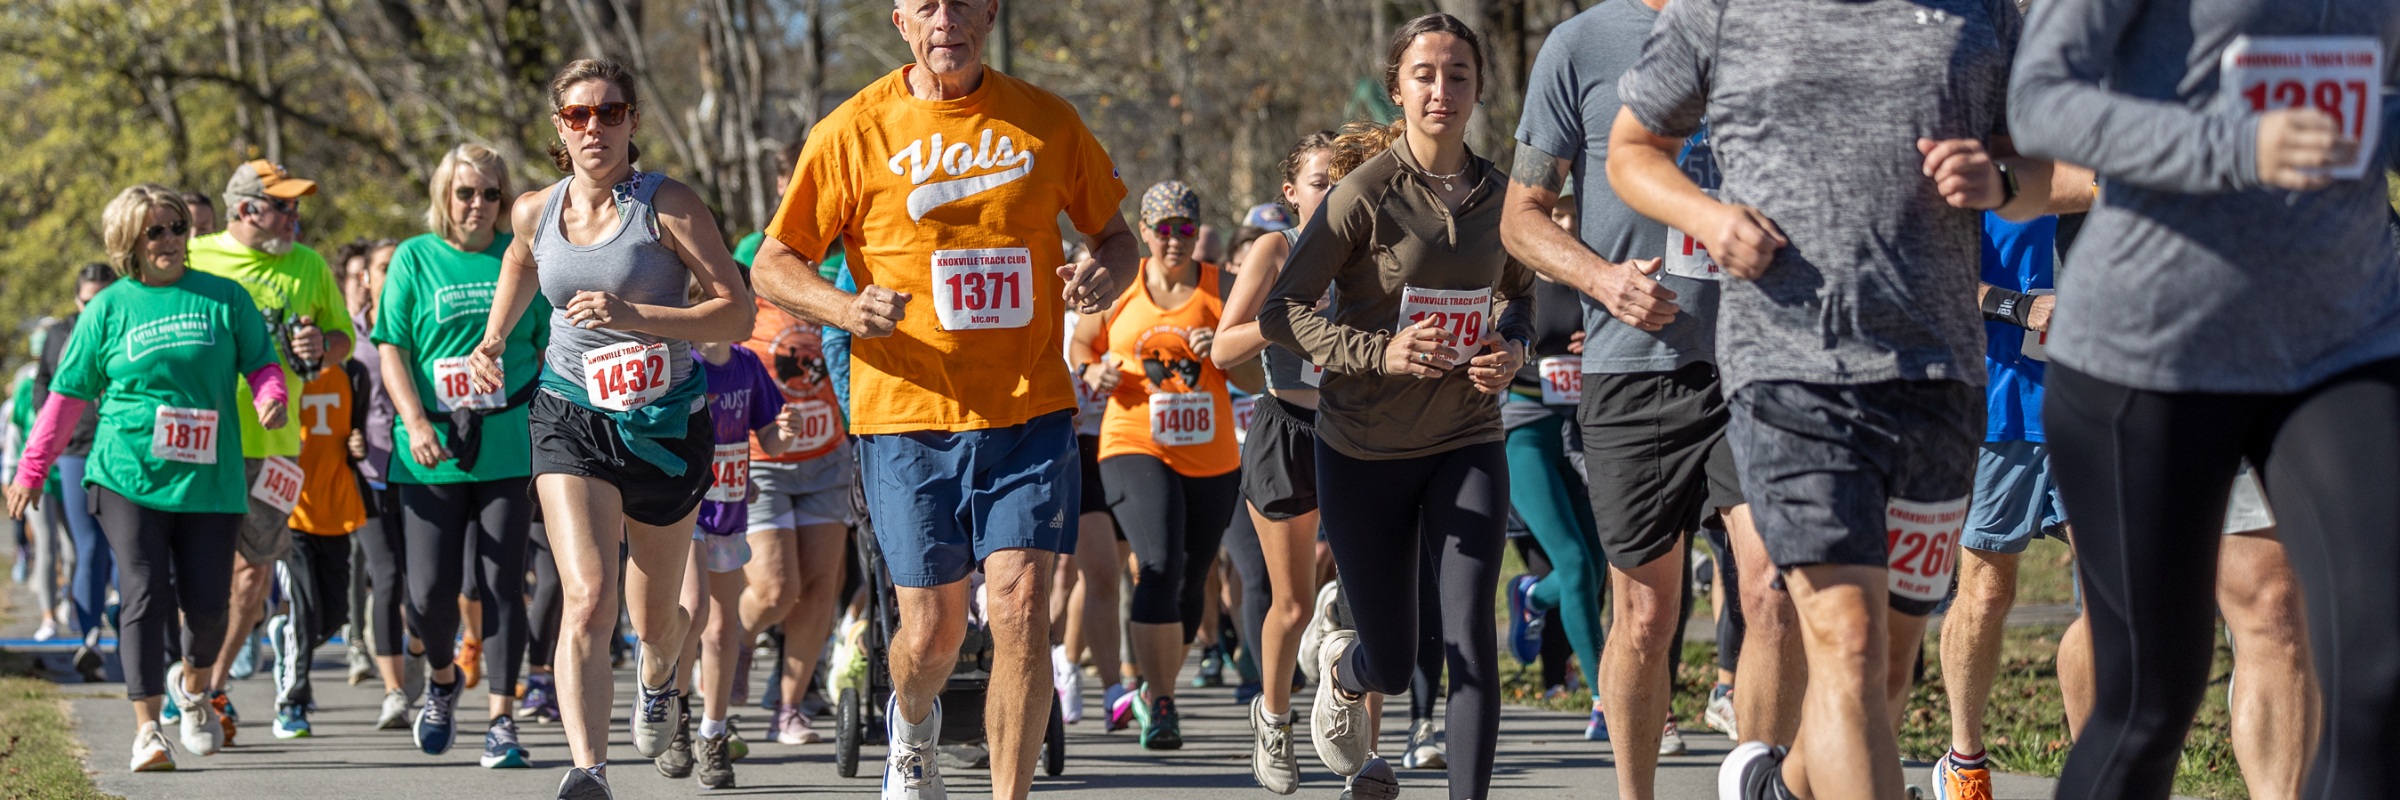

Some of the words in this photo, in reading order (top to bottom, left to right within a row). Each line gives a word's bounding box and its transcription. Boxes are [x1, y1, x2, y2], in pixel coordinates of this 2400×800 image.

[888, 128, 1034, 186] Vols
[937, 257, 979, 267] KNOXVILLE
[980, 256, 1006, 265] TRACK
[1007, 255, 1027, 265] CLUB
[945, 271, 1020, 311] 1371
[1408, 294, 1448, 306] KNOXVILLE
[1449, 297, 1473, 306] TRACK
[1473, 295, 1488, 305] CLUB
[971, 315, 999, 324] ktc.org
[587, 348, 622, 365] KNOXVILLE
[622, 344, 645, 356] TRACK
[592, 354, 665, 401] 1432
[621, 396, 646, 407] ktc.org
[720, 389, 752, 410] JUST
[302, 393, 340, 435] T
[1155, 407, 1210, 434] 1408
[164, 421, 211, 451] 1817
[1888, 527, 1960, 578] 1260
